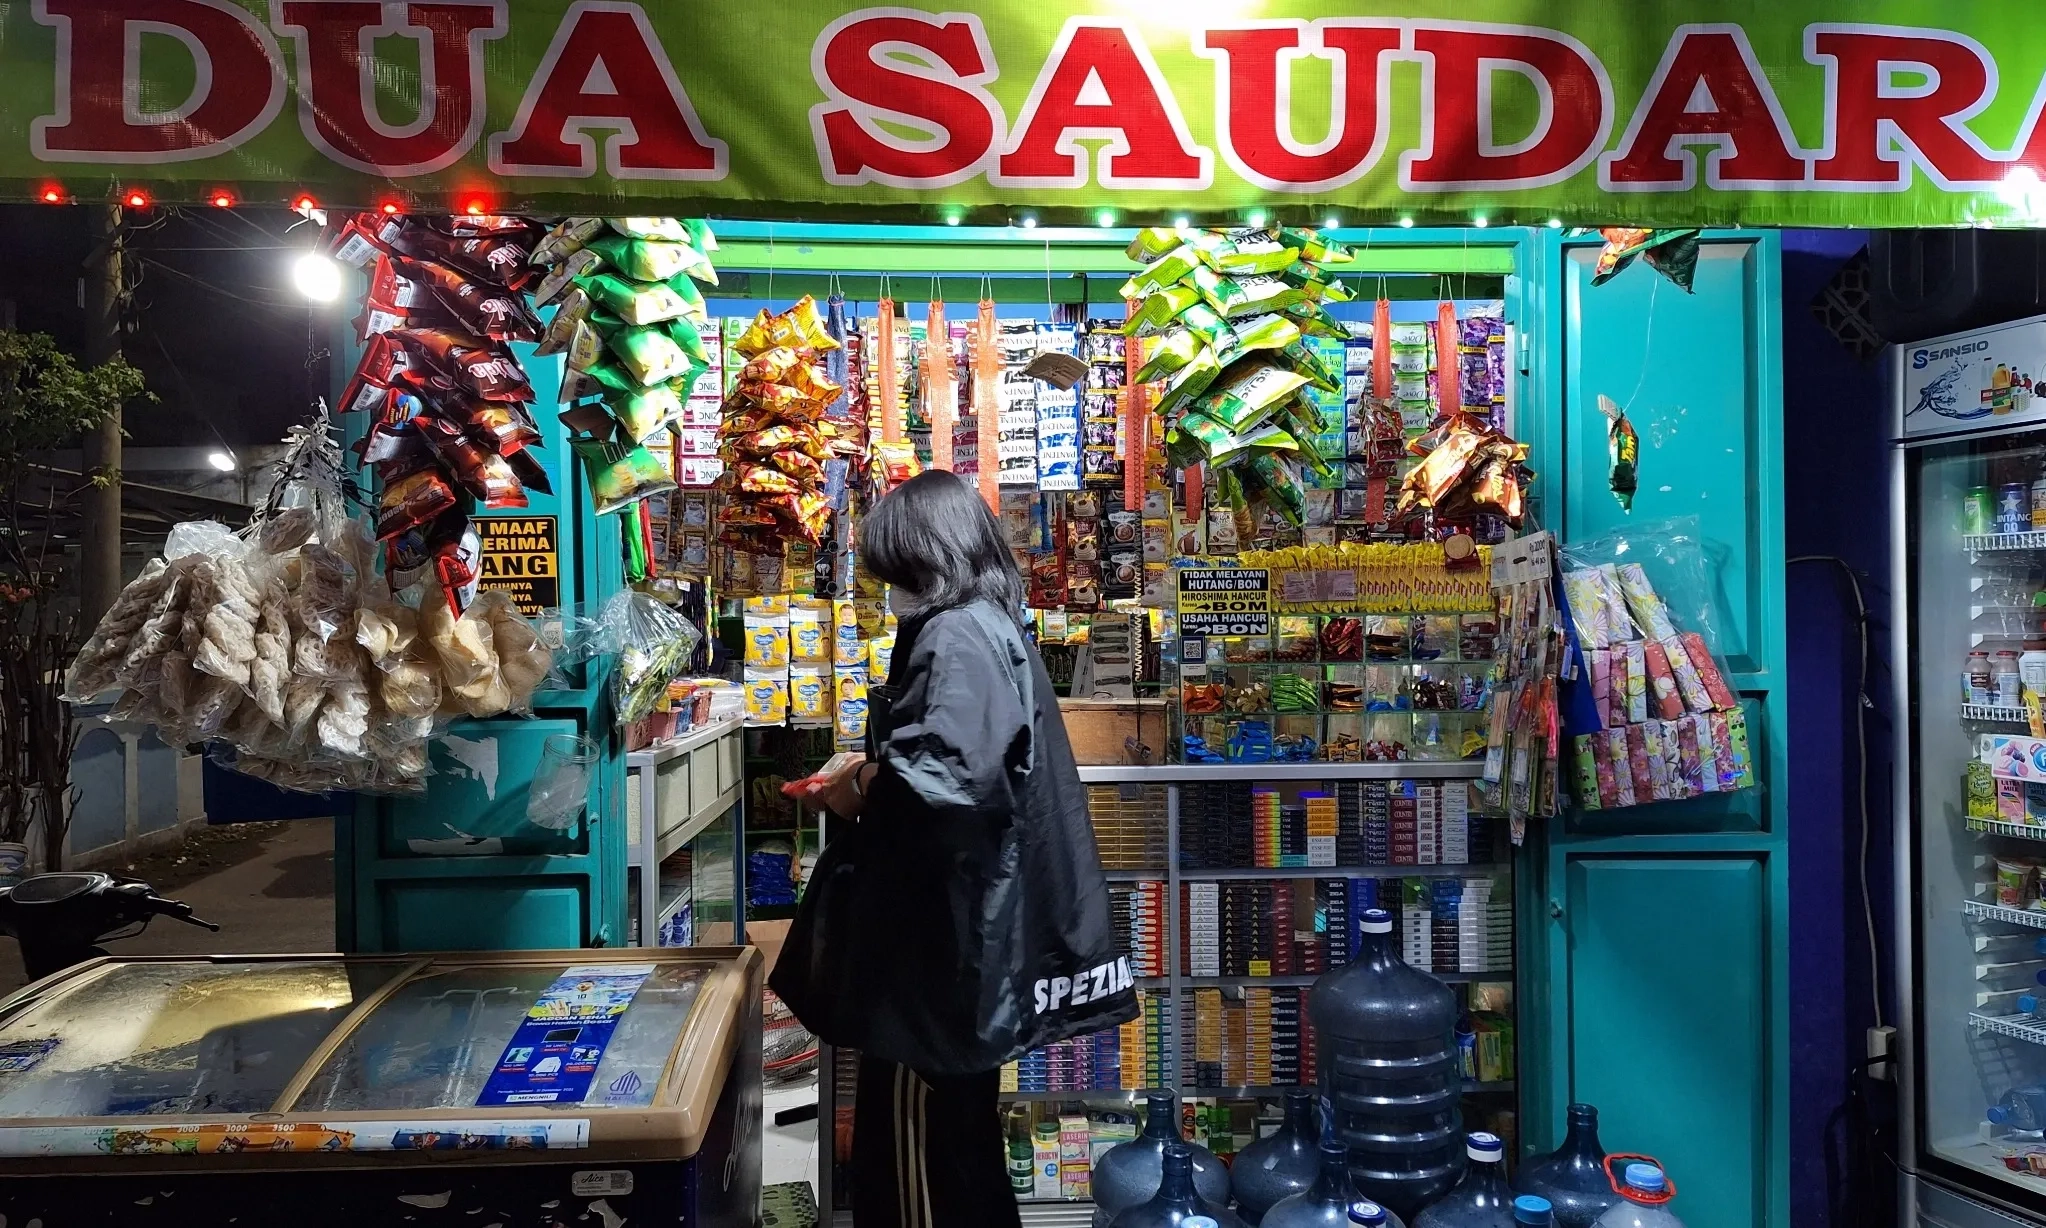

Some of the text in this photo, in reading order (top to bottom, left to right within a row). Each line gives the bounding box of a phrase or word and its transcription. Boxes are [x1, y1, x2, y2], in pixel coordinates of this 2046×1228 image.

[30, 0, 2046, 196] DUA SAUDAR
[1402, 334, 1422, 343] Dove
[1348, 350, 1369, 359] Dove
[1929, 340, 1989, 362] SANSIO
[1402, 362, 1423, 371] Dove
[1349, 377, 1365, 387] Dov
[1402, 390, 1423, 399] Dove
[699, 441, 719, 450] ZINC
[956, 448, 979, 457] NTENE
[1041, 450, 1076, 458] PANTENE
[699, 470, 720, 480] ZINC
[1001, 473, 1035, 481] PANTENE
[1042, 479, 1077, 487] PANTENE
[489, 522, 548, 535] MAAF
[483, 538, 550, 551] ERIMA
[482, 556, 549, 576] ANG
[1216, 570, 1266, 578] MELAYANI
[1188, 579, 1261, 590] HUTANG/BON
[1181, 592, 1267, 601] HIROSHIMA HANCUR
[1213, 601, 1267, 611] BOM
[1182, 613, 1267, 623] USAHA HANCUR
[1213, 624, 1267, 634] BON
[1034, 955, 1135, 1015] SPEZIA
[177, 1125, 200, 1134] 3000
[225, 1124, 248, 1133] 3000
[272, 1123, 295, 1132] 3500
[1062, 1132, 1088, 1141] LASERIN
[1035, 1151, 1059, 1161] HEROCYN
[1063, 1172, 1088, 1181] LASERIN
